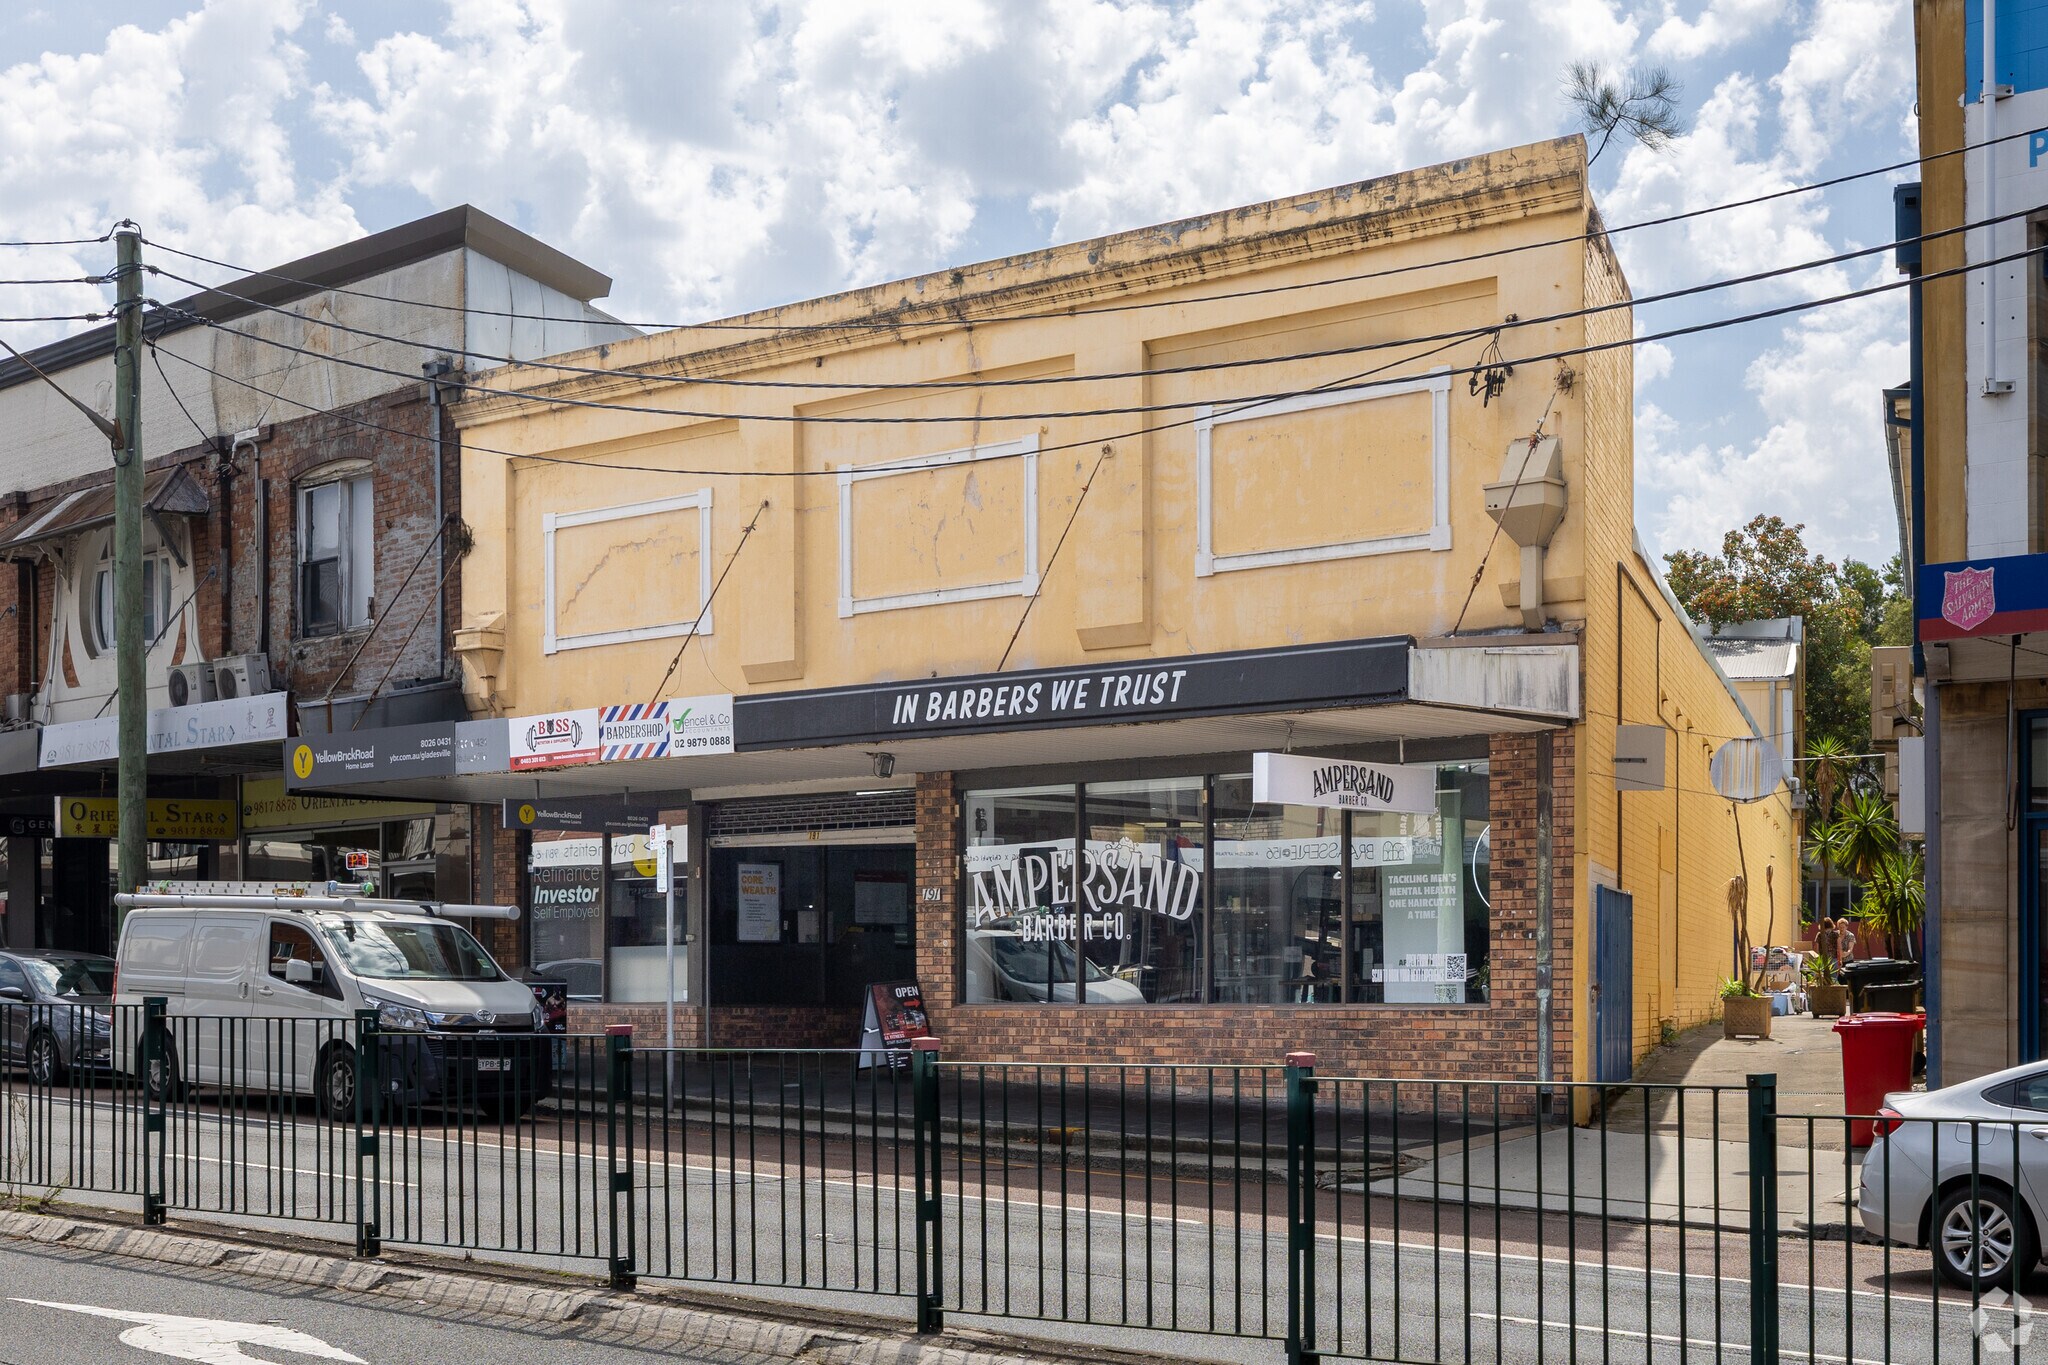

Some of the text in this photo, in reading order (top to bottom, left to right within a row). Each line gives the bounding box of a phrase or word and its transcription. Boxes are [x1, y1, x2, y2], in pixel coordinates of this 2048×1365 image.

[1953, 573, 1974, 594] THE
[1946, 575, 1990, 616] SALVATION
[1962, 596, 1987, 624] ARMY
[893, 670, 1186, 724] IN BARBERS WE TRUST
[709, 714, 716, 725] &
[606, 723, 663, 740] BARBERSHOP
[420, 739, 436, 748] 8026
[437, 738, 451, 746] 0431
[675, 736, 731, 748] 02 9879 0888
[315, 746, 374, 763] YellowBrickRoad
[390, 749, 451, 764] ybr.com.au/gladesville
[1313, 765, 1395, 803] AMPERSAND
[254, 799, 297, 815] 9817 8878
[1339, 794, 1370, 807] BARBER CO.
[70, 802, 214, 823] ORIEL STAR
[537, 810, 581, 819] YellowBrickRoad
[170, 826, 196, 835] 9817
[809, 832, 820, 840] 191
[533, 864, 600, 883] Refinance
[1388, 873, 1457, 884] TACKLING MEN'S
[534, 885, 600, 904] Investor
[923, 888, 939, 900] 191
[972, 848, 1200, 929] AMPERSAND
[1389, 885, 1456, 896] MENTAL HEALTH
[1389, 897, 1457, 908] ONE HAIRCUT AT
[534, 905, 600, 920] Self Employed
[1408, 911, 1414, 919] A
[1023, 913, 1132, 942] BARBER CO.
[895, 986, 919, 998] OPEN
